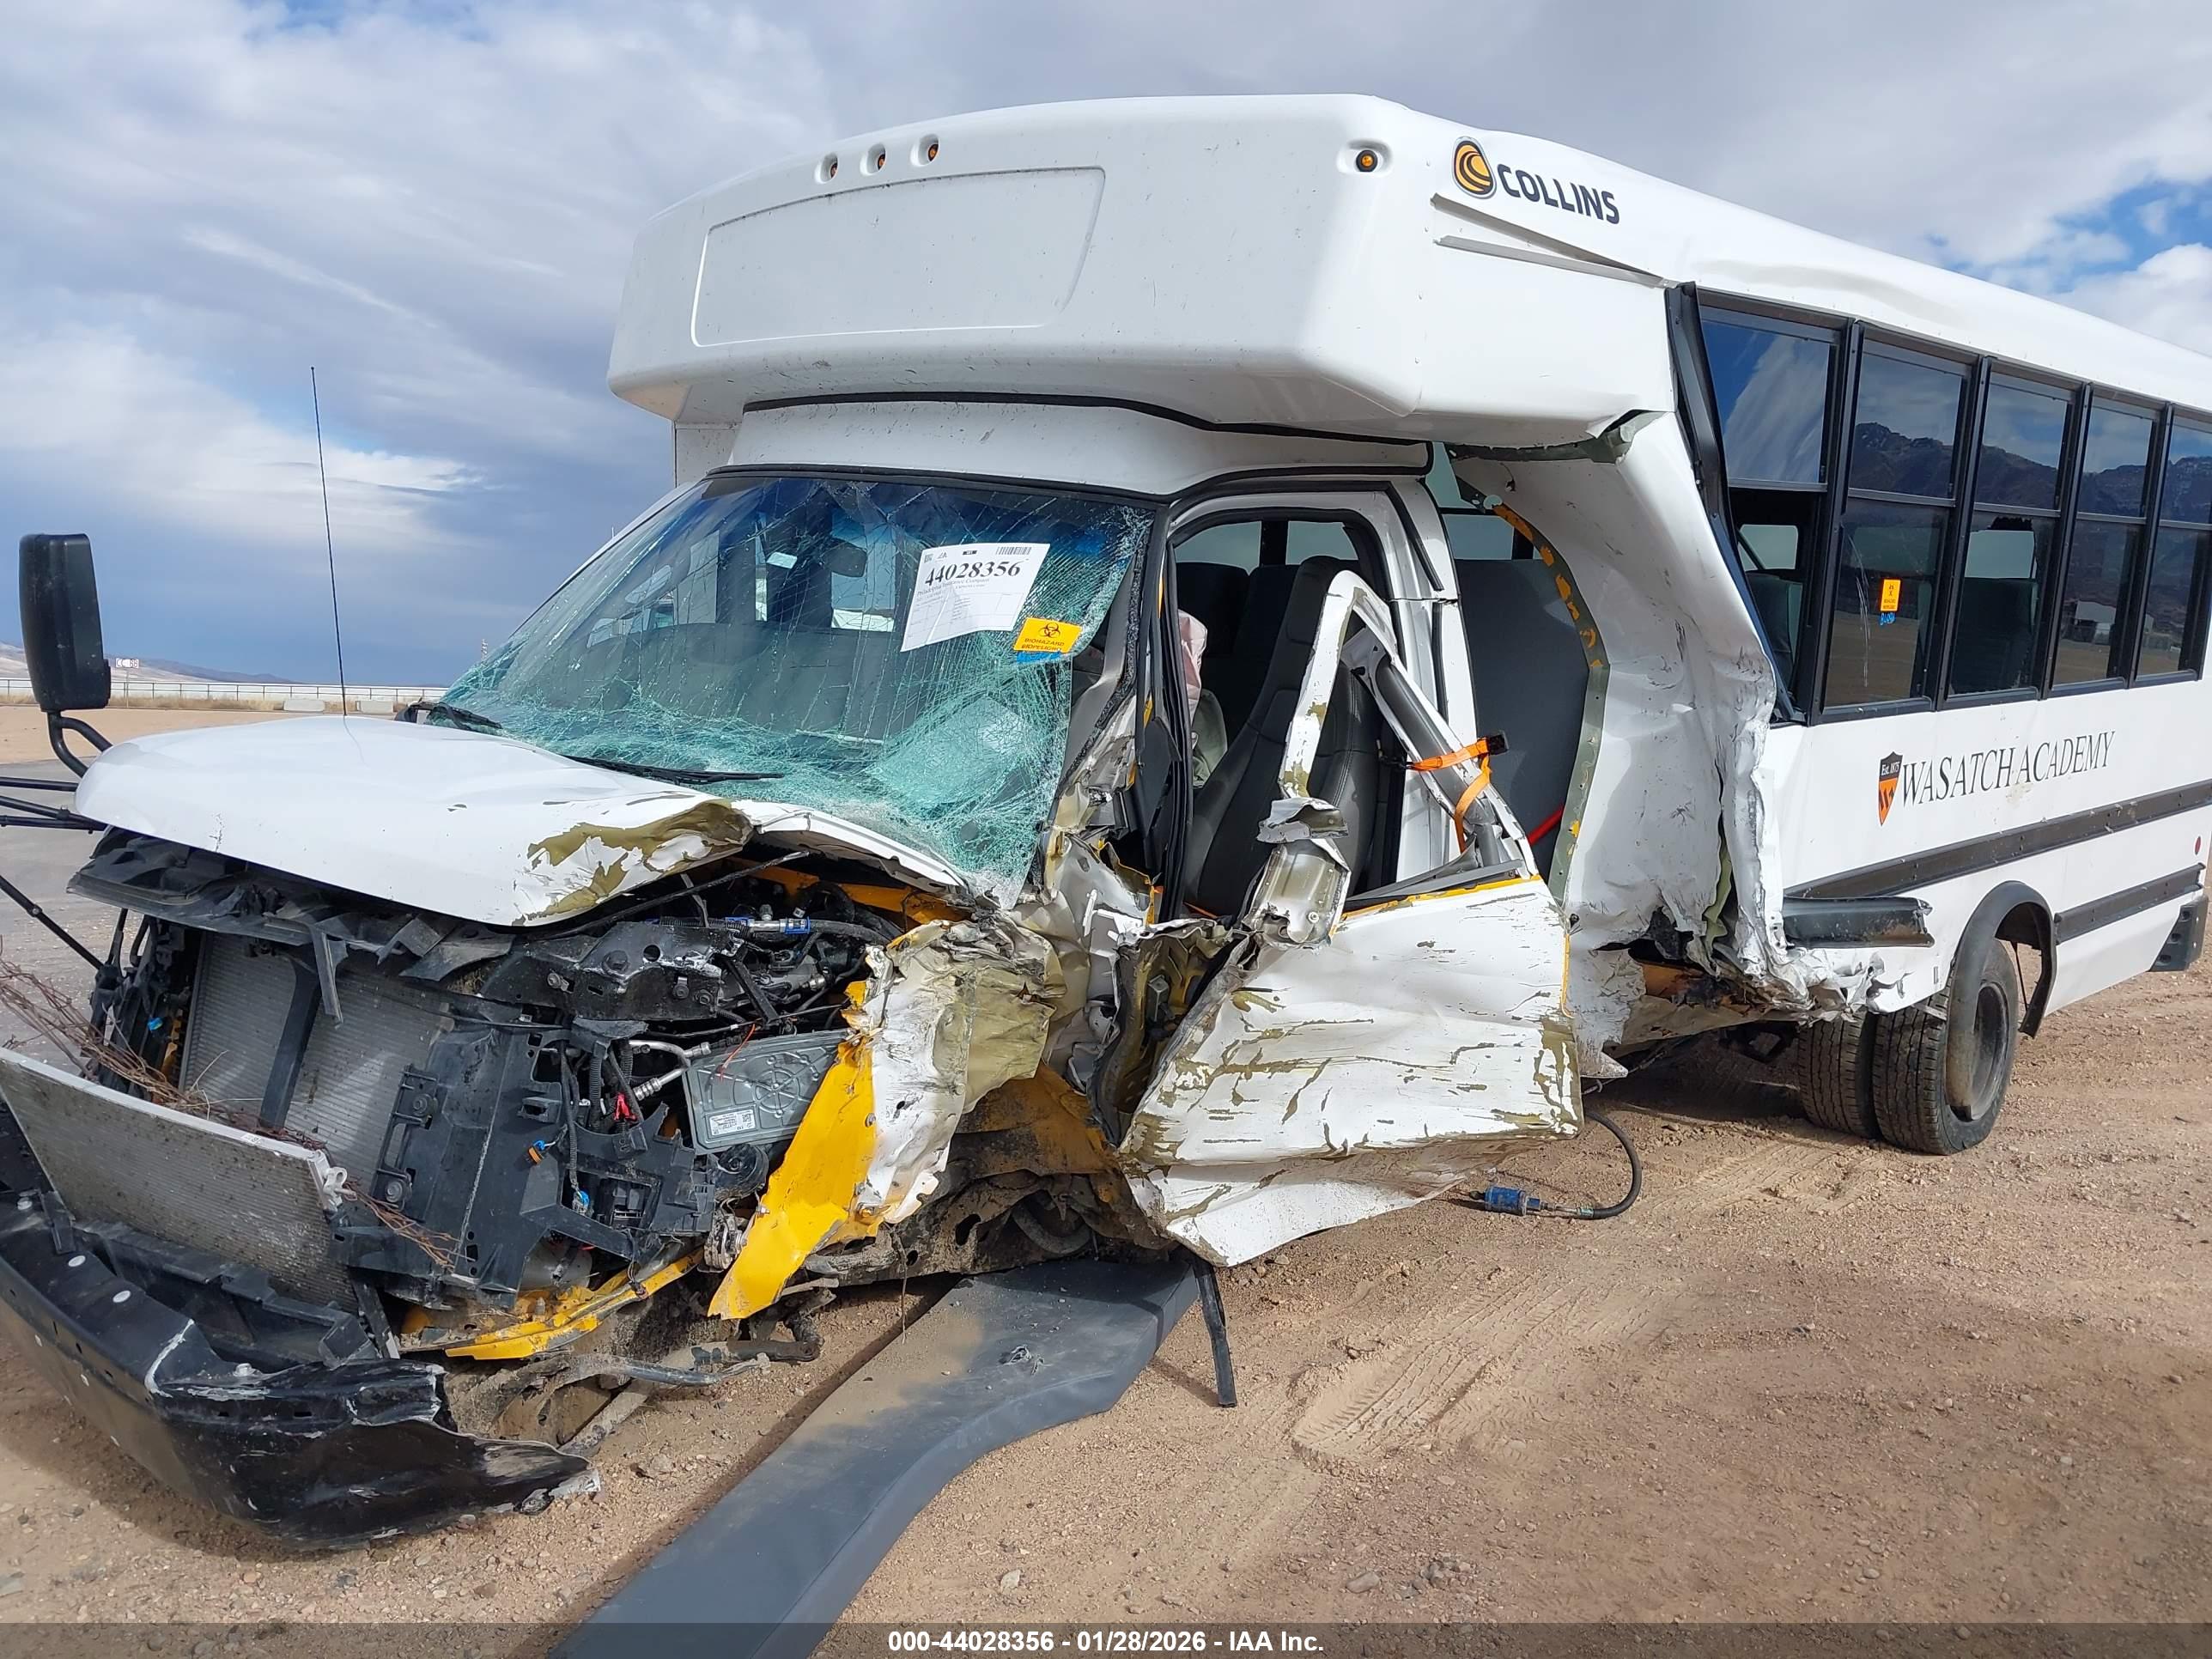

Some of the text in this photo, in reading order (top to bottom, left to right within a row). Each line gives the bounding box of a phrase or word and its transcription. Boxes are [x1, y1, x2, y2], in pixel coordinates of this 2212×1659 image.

[1497, 163, 1620, 224] COLLINS
[925, 561, 1022, 586] 44028356
[1903, 731, 2116, 807] WASATCH ACADEMY
